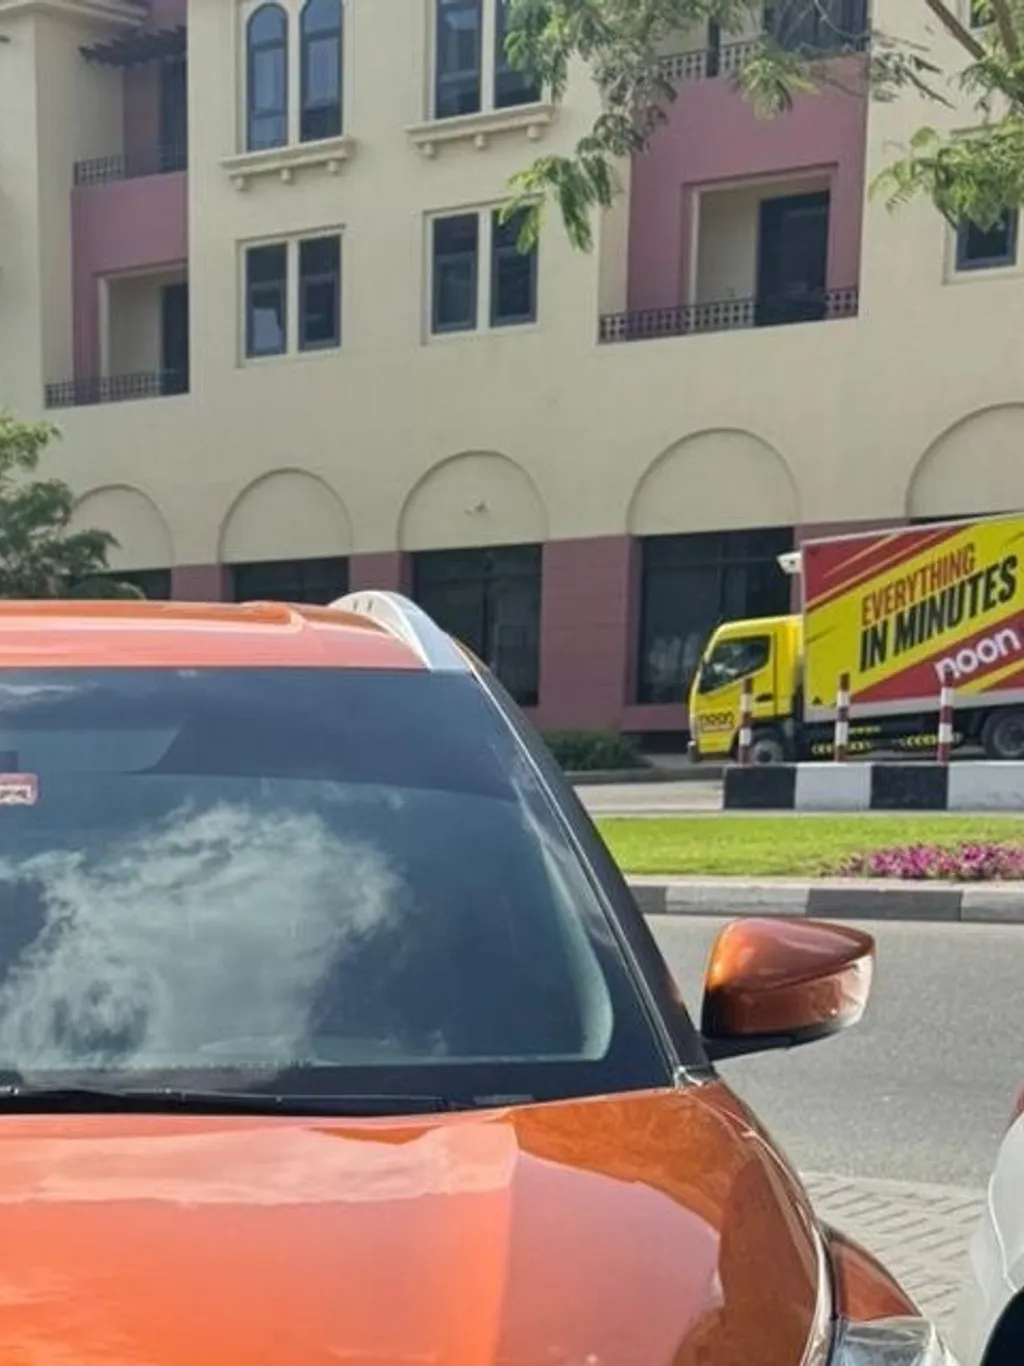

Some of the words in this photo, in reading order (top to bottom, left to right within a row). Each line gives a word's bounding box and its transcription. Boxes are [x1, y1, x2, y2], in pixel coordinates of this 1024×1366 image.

[860, 619, 888, 673] IN
[893, 554, 1018, 657] MINUTES
[861, 542, 975, 627] EVERYTHING
[933, 628, 1022, 684] noon
